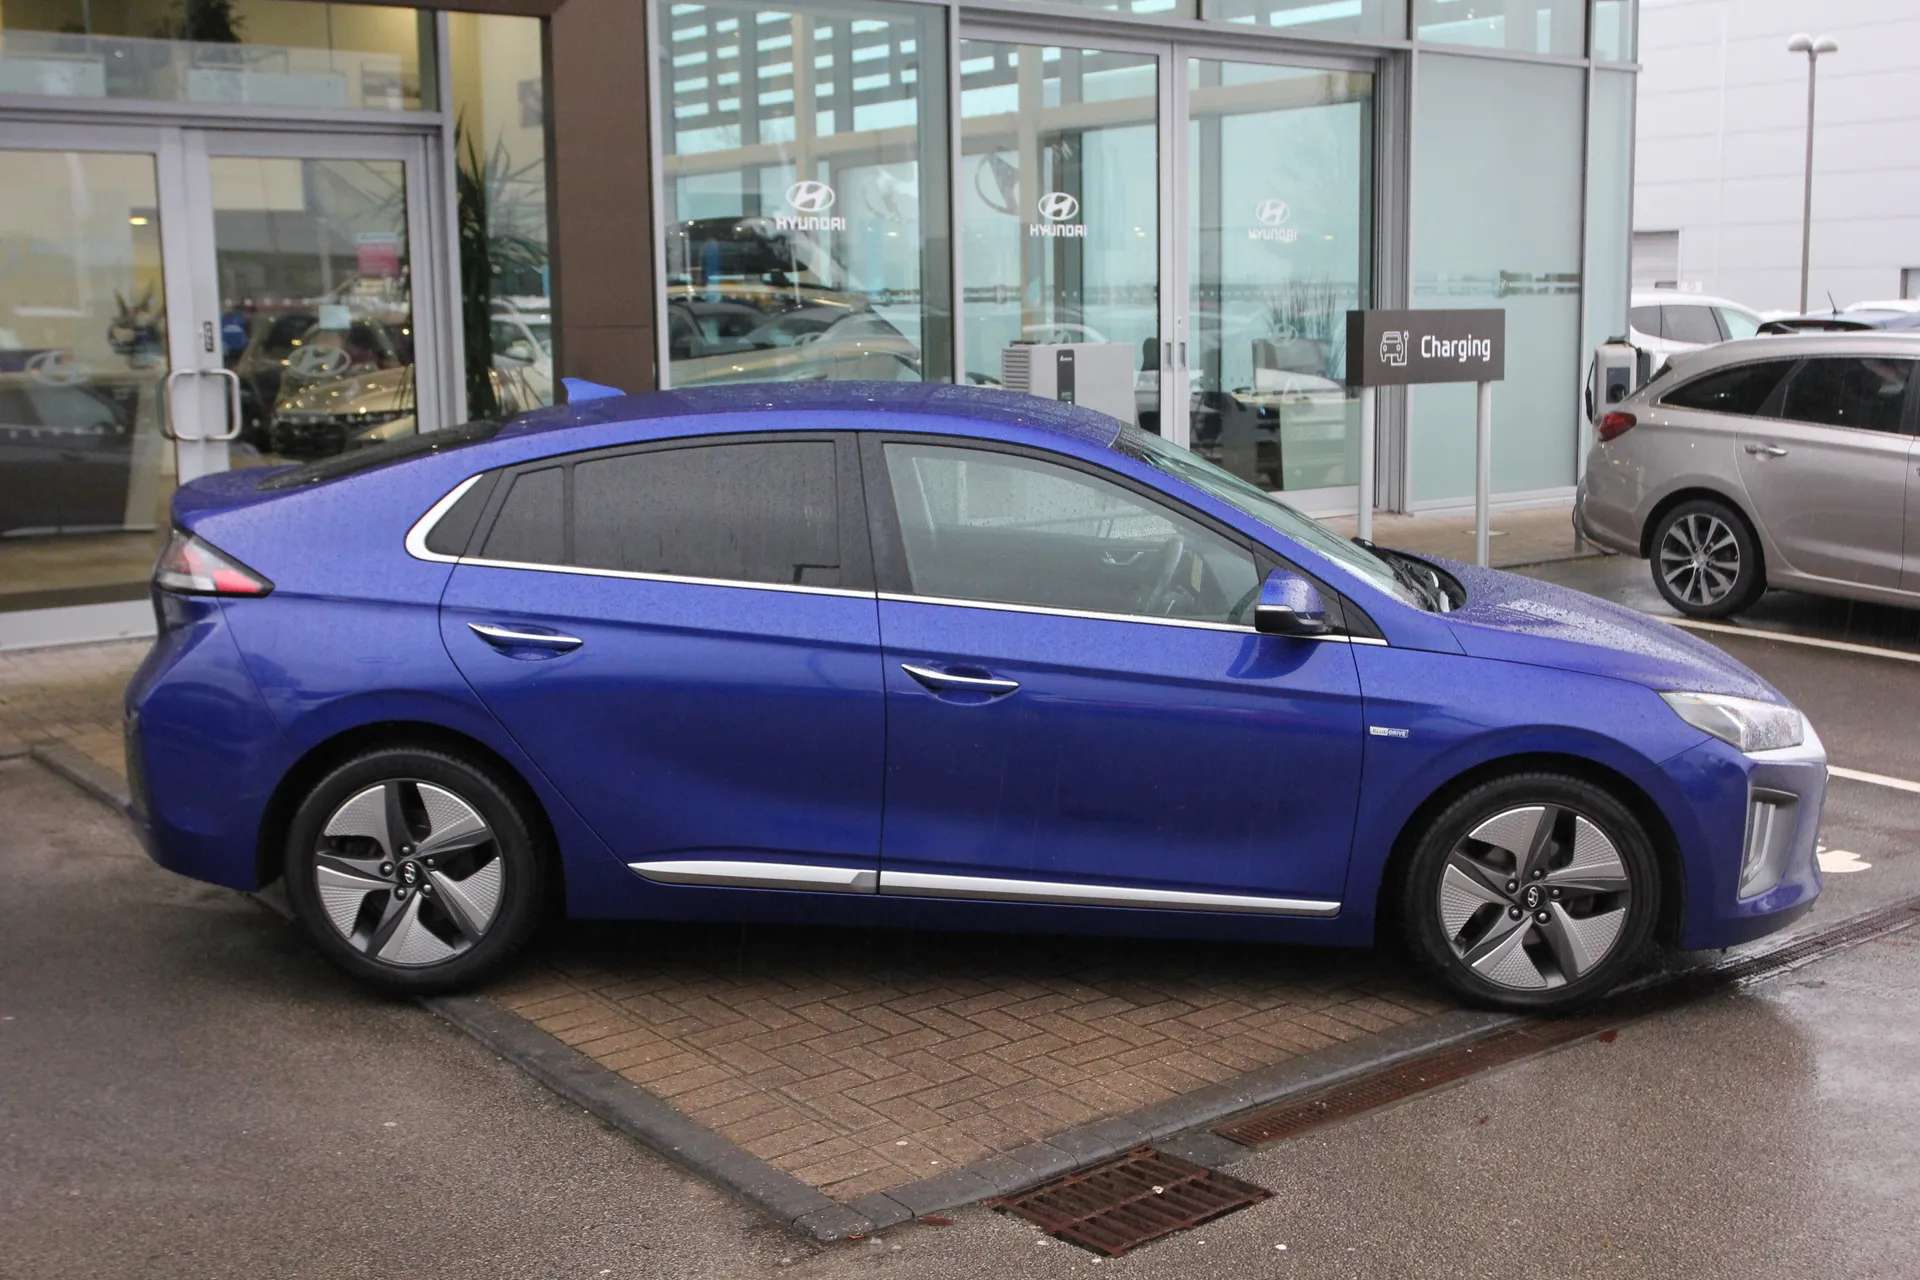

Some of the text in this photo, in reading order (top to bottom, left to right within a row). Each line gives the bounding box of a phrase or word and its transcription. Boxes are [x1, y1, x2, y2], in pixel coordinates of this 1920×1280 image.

[776, 216, 846, 231] HYUNDAI
[1030, 224, 1088, 237] HYUNDAI
[1421, 334, 1491, 362] Charging
